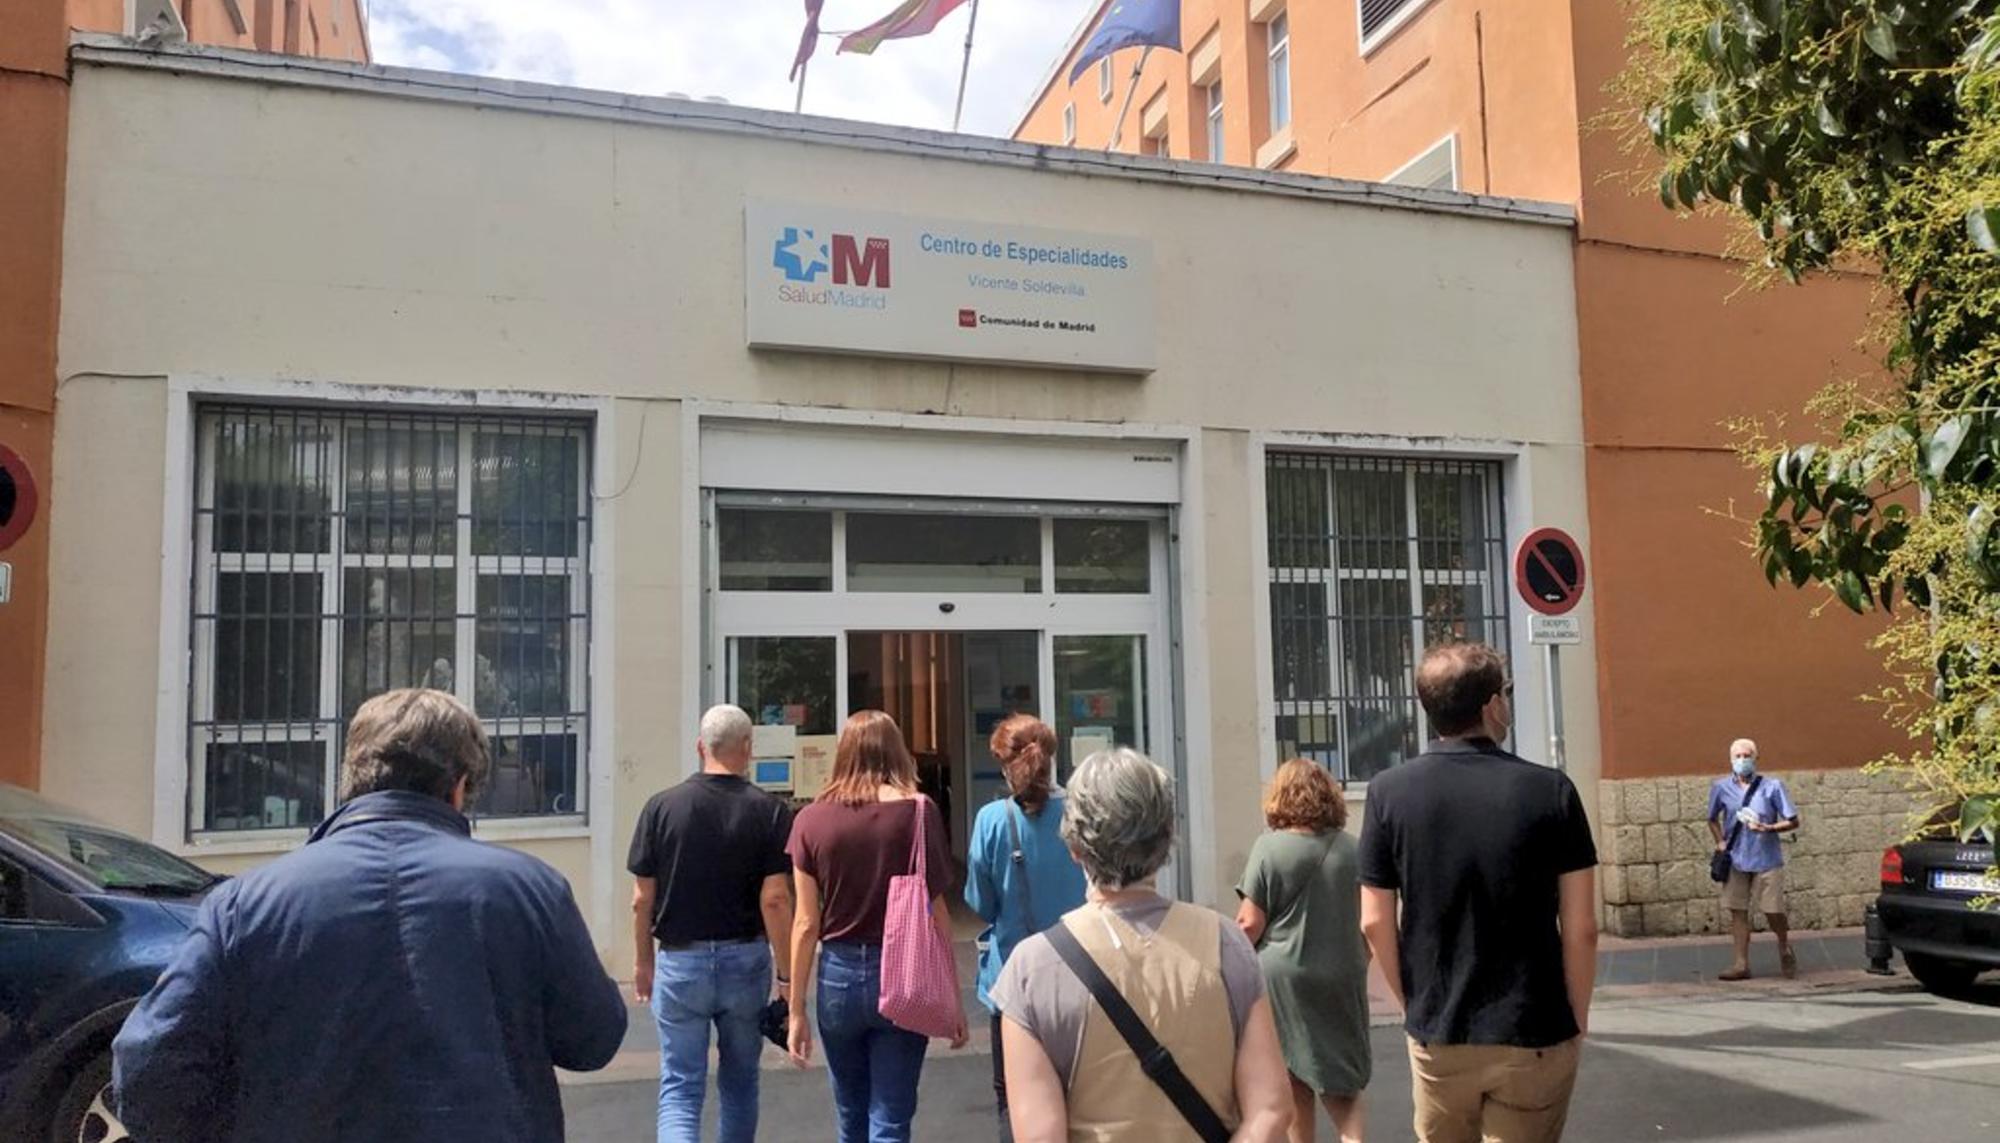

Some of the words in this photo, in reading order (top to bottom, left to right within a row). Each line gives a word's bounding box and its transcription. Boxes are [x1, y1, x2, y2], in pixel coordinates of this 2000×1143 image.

[920, 233, 978, 256] Centro
[982, 240, 1002, 258] de
[1007, 242, 1129, 270] Especialidades
[778, 284, 886, 310] SaludMadrid
[967, 273, 1018, 291] Vicente
[1022, 278, 1086, 297] Soldevilla
[979, 314, 1040, 329] Comunidad
[1043, 320, 1055, 330] de
[1058, 320, 1097, 333] Madrid
